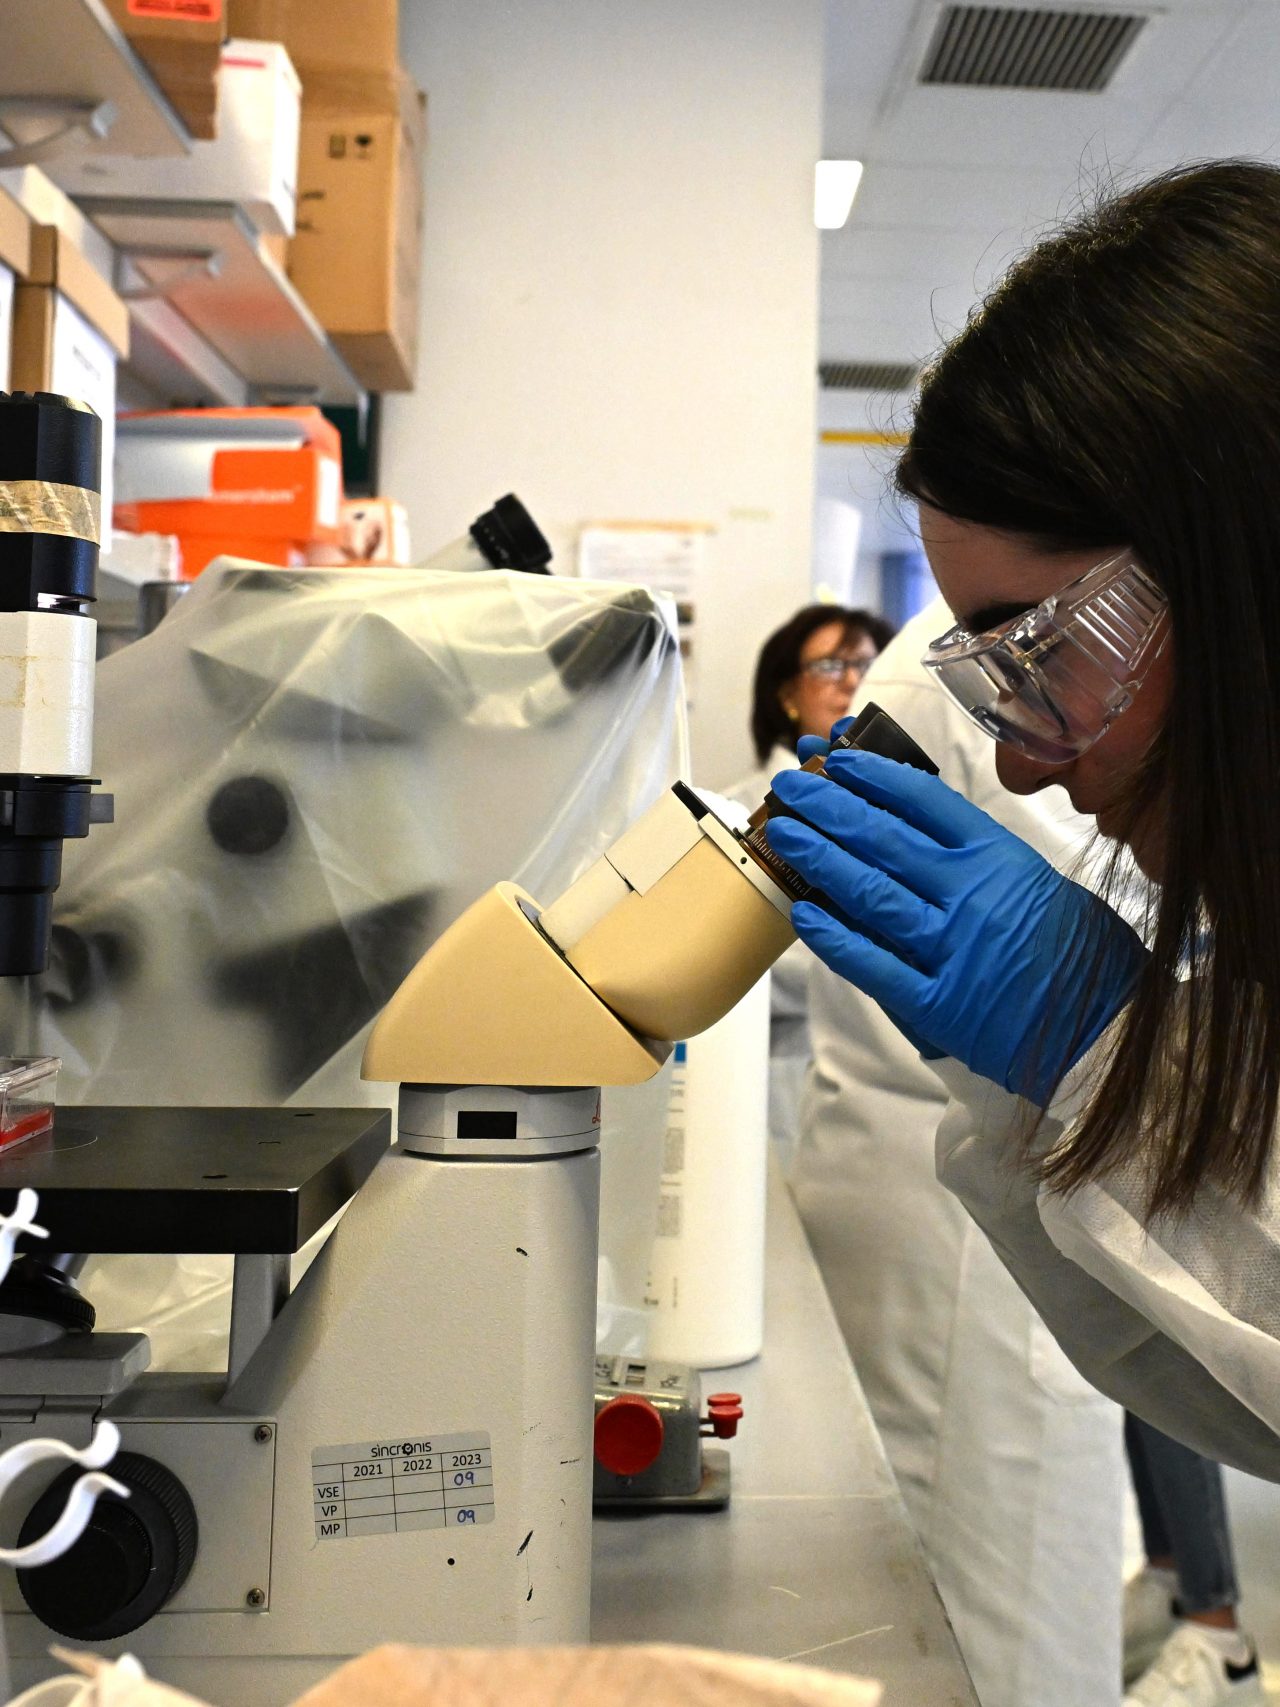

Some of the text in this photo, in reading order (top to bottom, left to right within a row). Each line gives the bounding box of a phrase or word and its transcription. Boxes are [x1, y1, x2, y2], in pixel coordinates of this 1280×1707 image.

[353, 1454, 482, 1477] 2021 2022 2023
[454, 1471, 474, 1486] 09
[318, 1486, 340, 1499] VSE
[322, 1505, 338, 1517] VP
[457, 1509, 476, 1523] 09
[320, 1523, 341, 1536] MP
